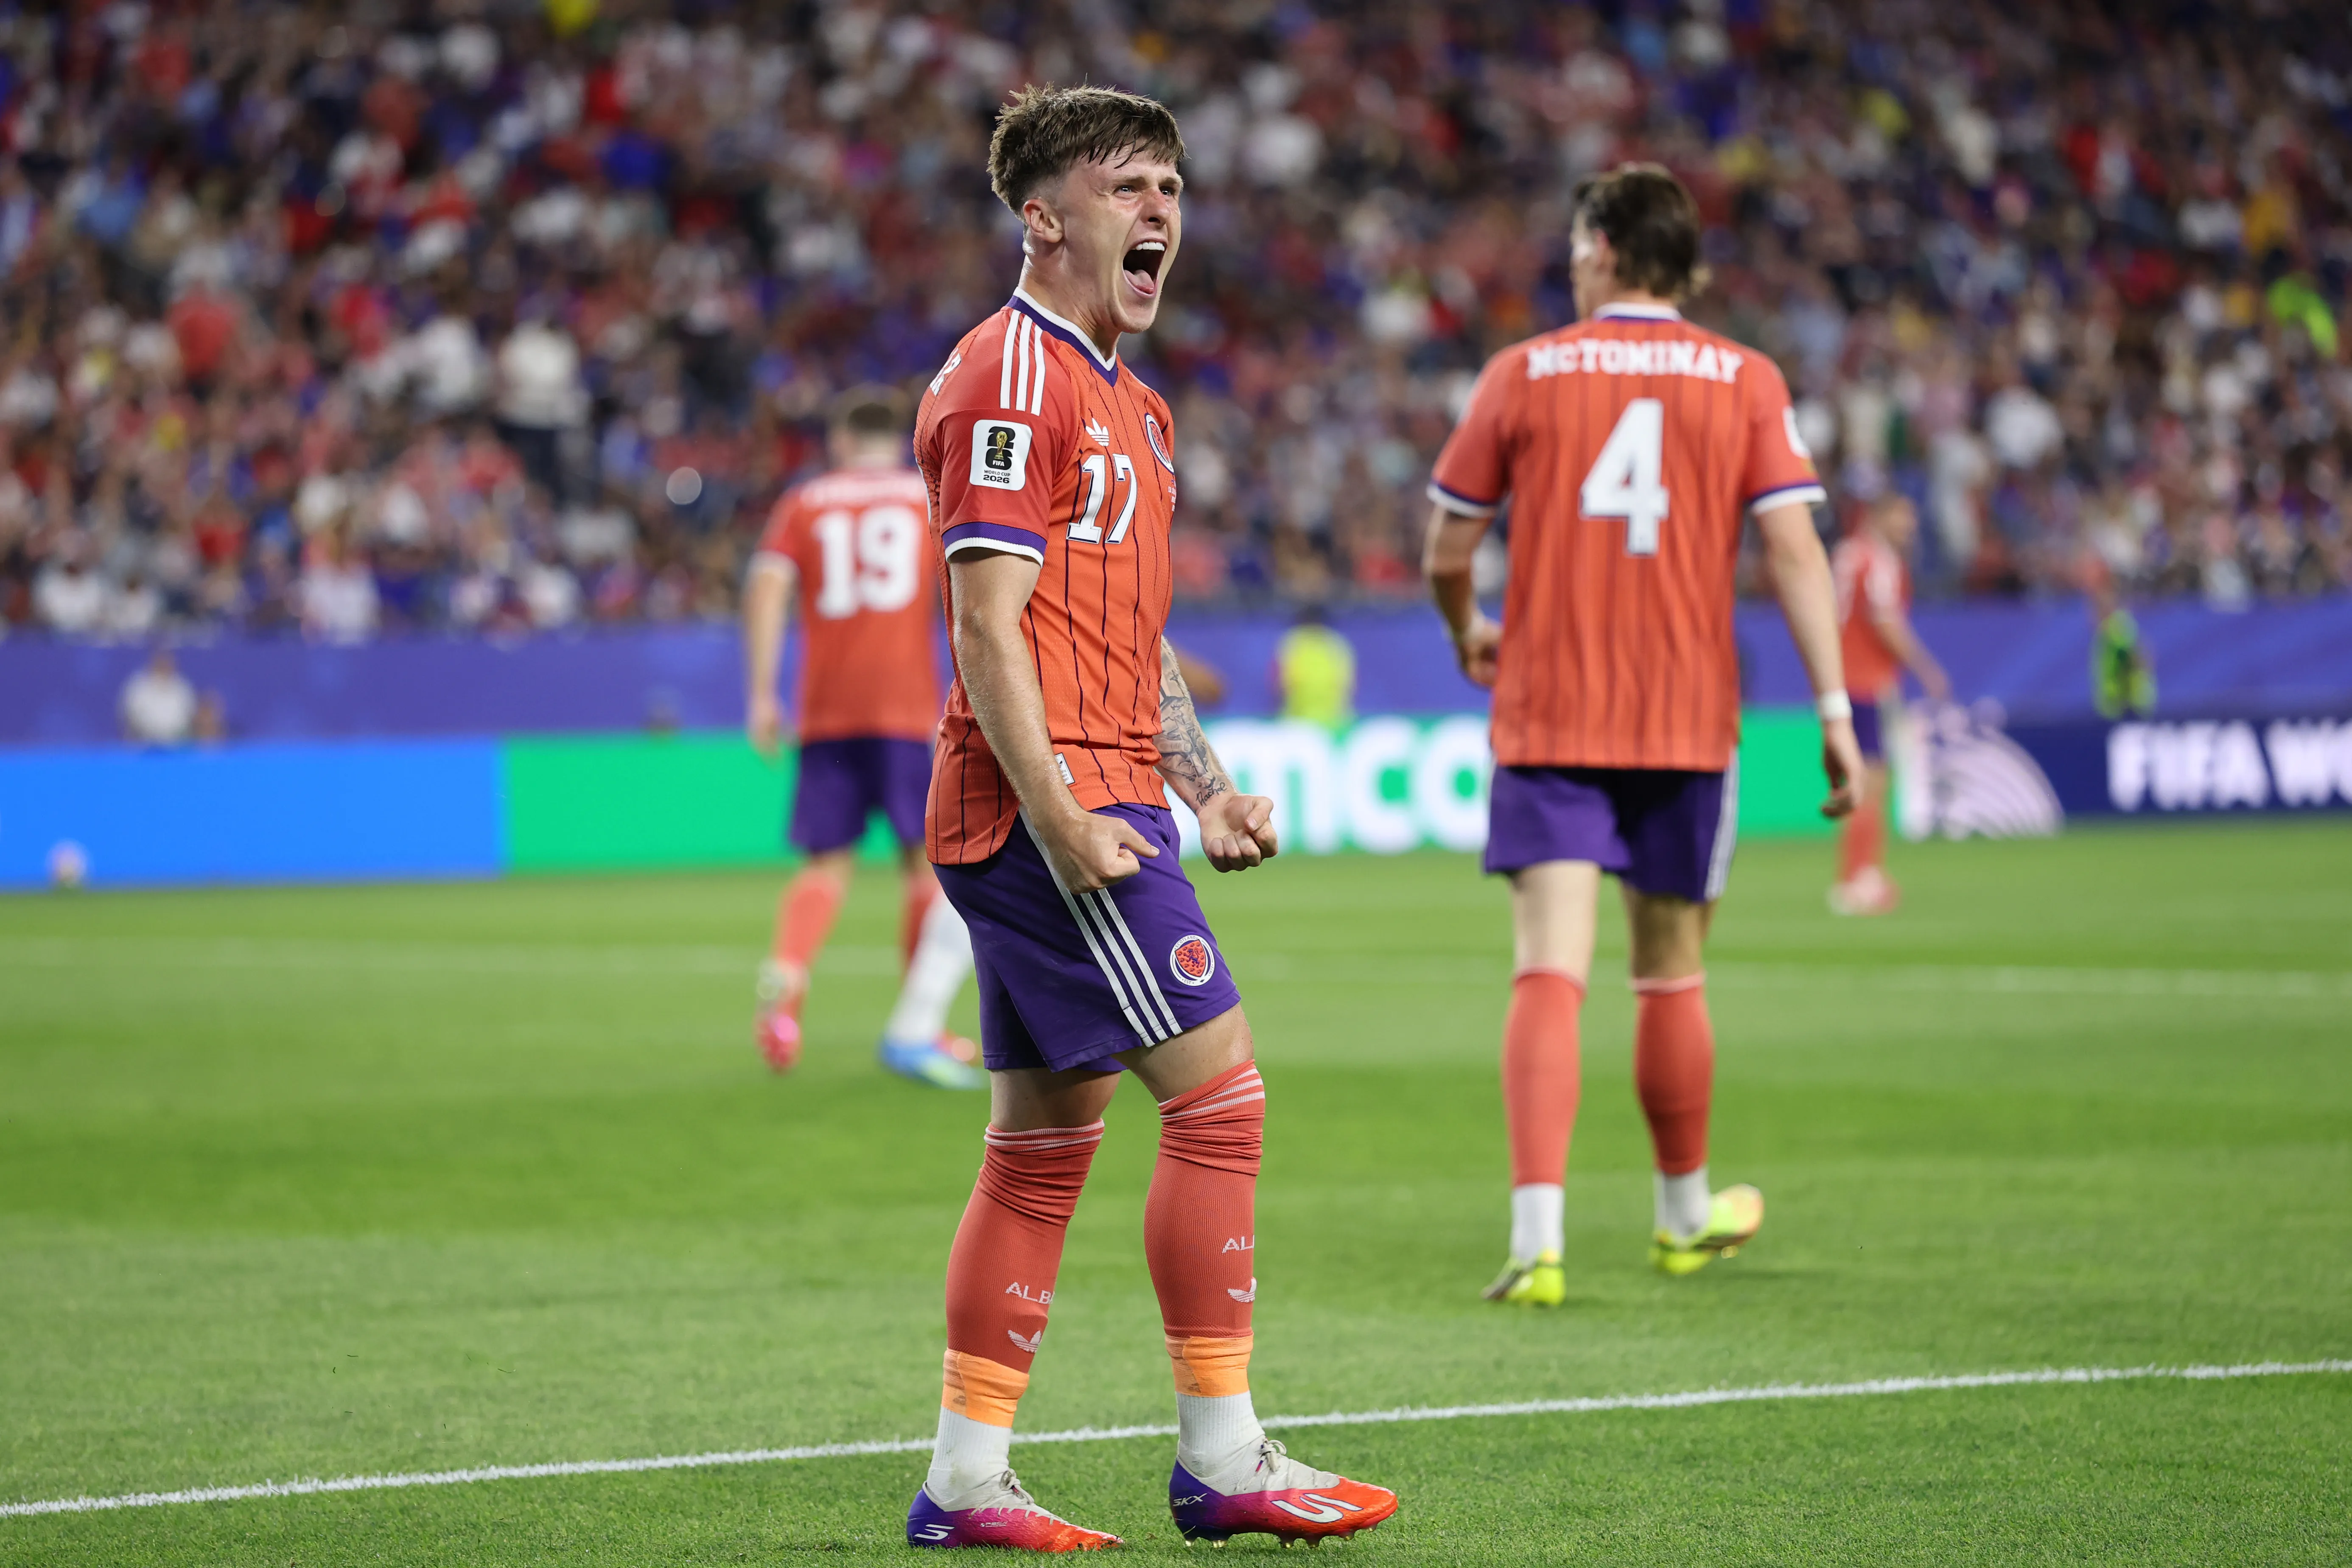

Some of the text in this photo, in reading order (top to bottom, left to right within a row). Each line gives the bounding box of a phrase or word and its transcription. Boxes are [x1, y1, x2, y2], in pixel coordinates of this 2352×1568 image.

[983, 474, 1010, 484] 2026
[1580, 398, 1669, 557] 4
[1066, 454, 1137, 545] 17
[814, 508, 920, 618] 19
[2108, 719, 2352, 810] FIFA W
[1179, 715, 1492, 855] mco
[1196, 782, 1228, 806] Rachel
[1175, 935, 1196, 948] SCOTLAND
[1222, 1235, 1254, 1254] AL
[1005, 1282, 1055, 1304] ALB
[1173, 1493, 1208, 1506] SKX
